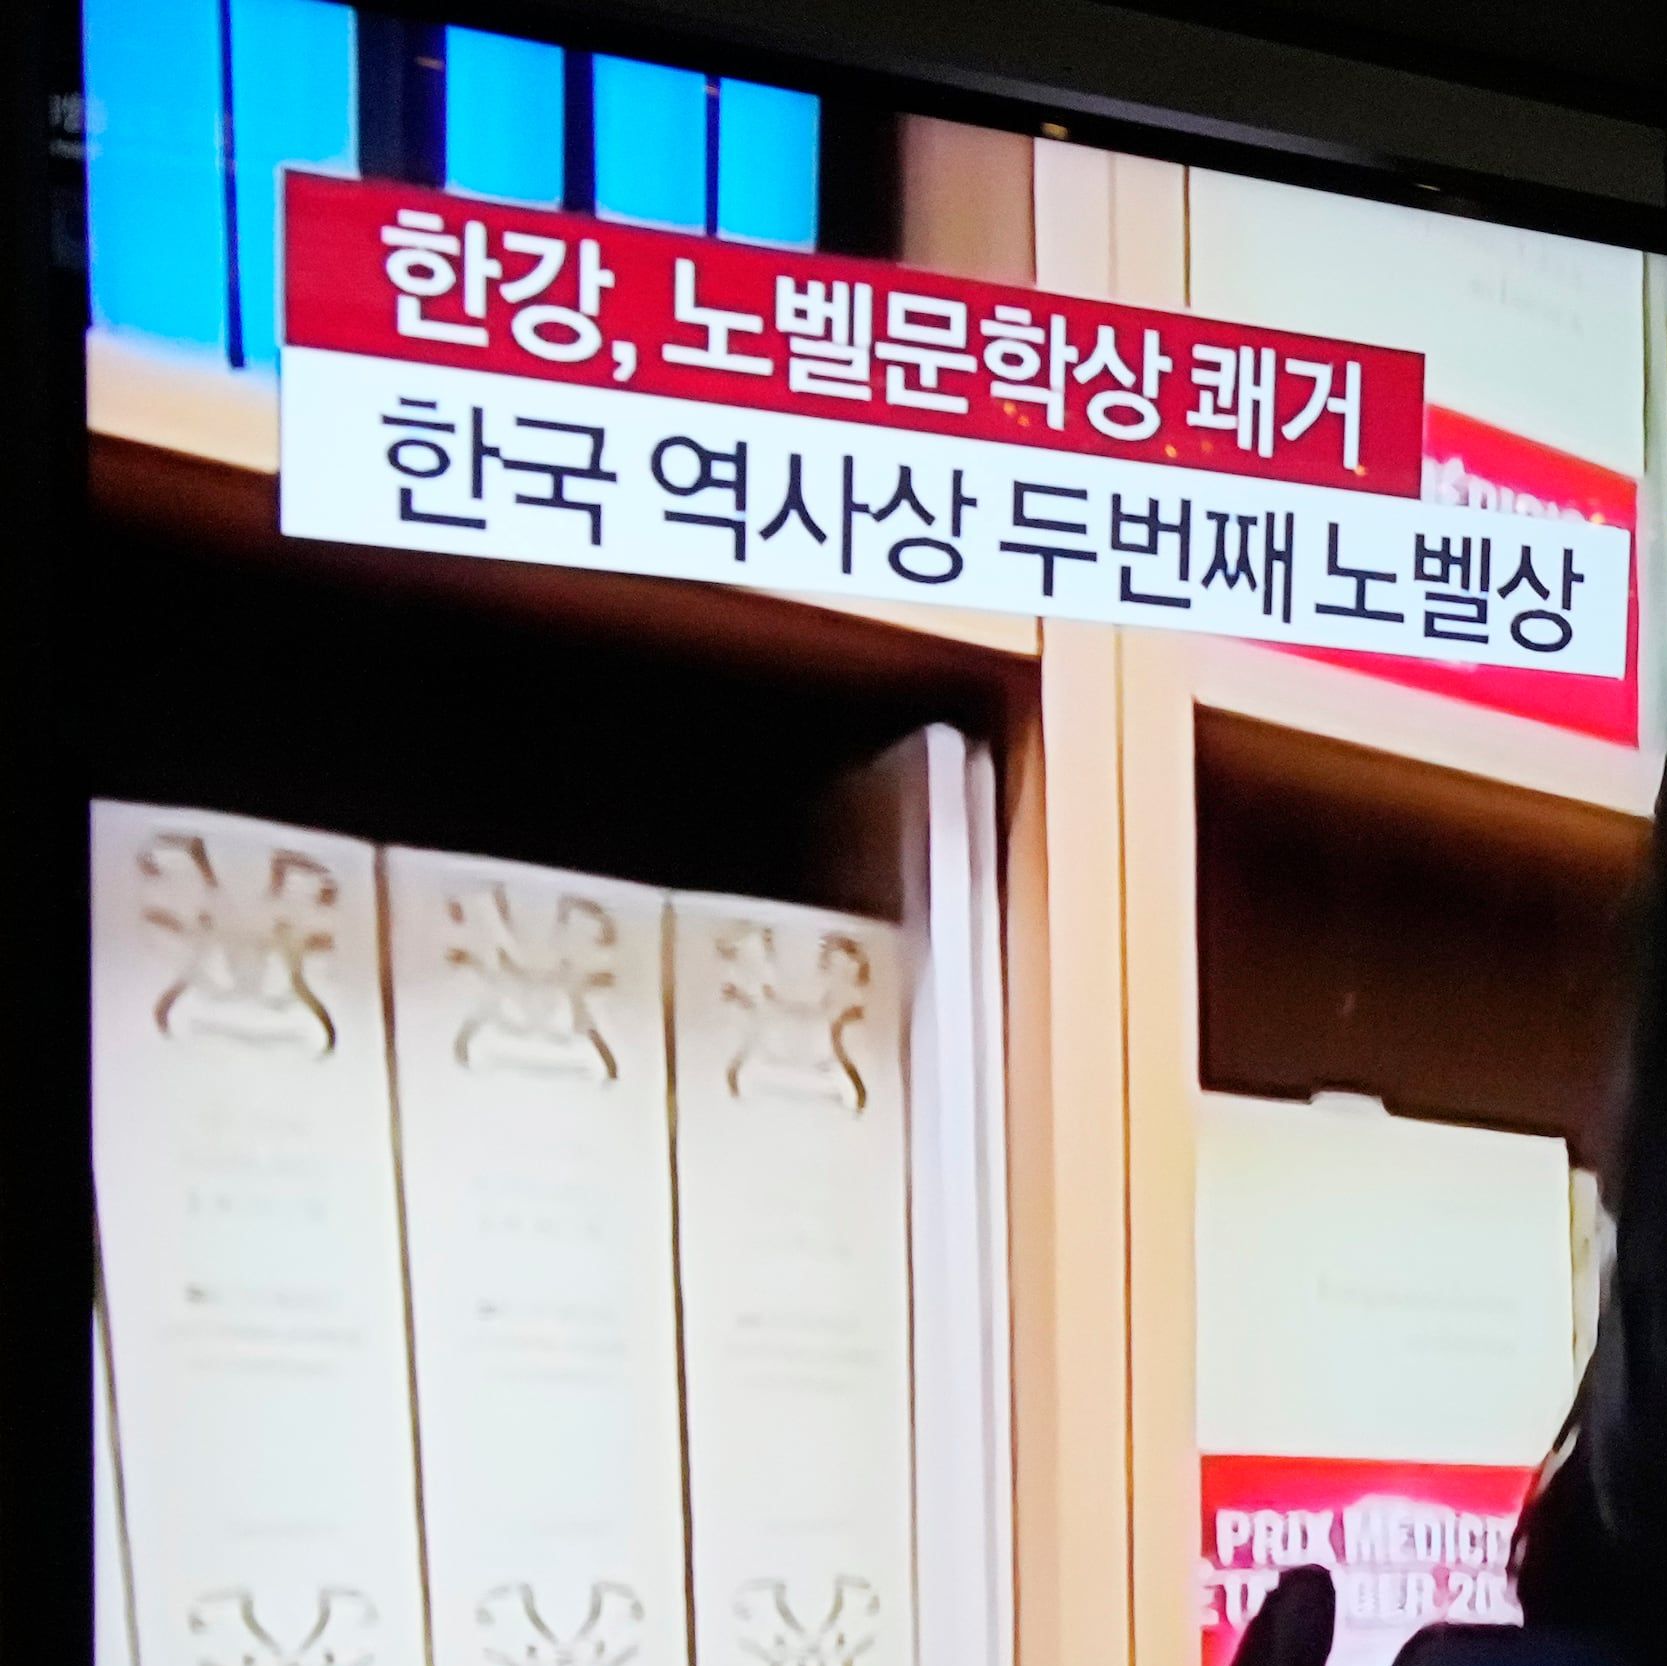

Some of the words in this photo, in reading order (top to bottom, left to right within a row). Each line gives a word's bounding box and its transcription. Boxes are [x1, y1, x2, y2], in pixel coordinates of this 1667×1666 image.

[380, 209, 638, 383] 한강,
[661, 257, 1172, 442] 노벨문학상
[1187, 338, 1364, 470] 쾌거
[380, 396, 618, 547] 한국
[650, 434, 977, 586] 역사상
[998, 479, 1295, 623] 두번째
[1314, 520, 1585, 655] 노벨상
